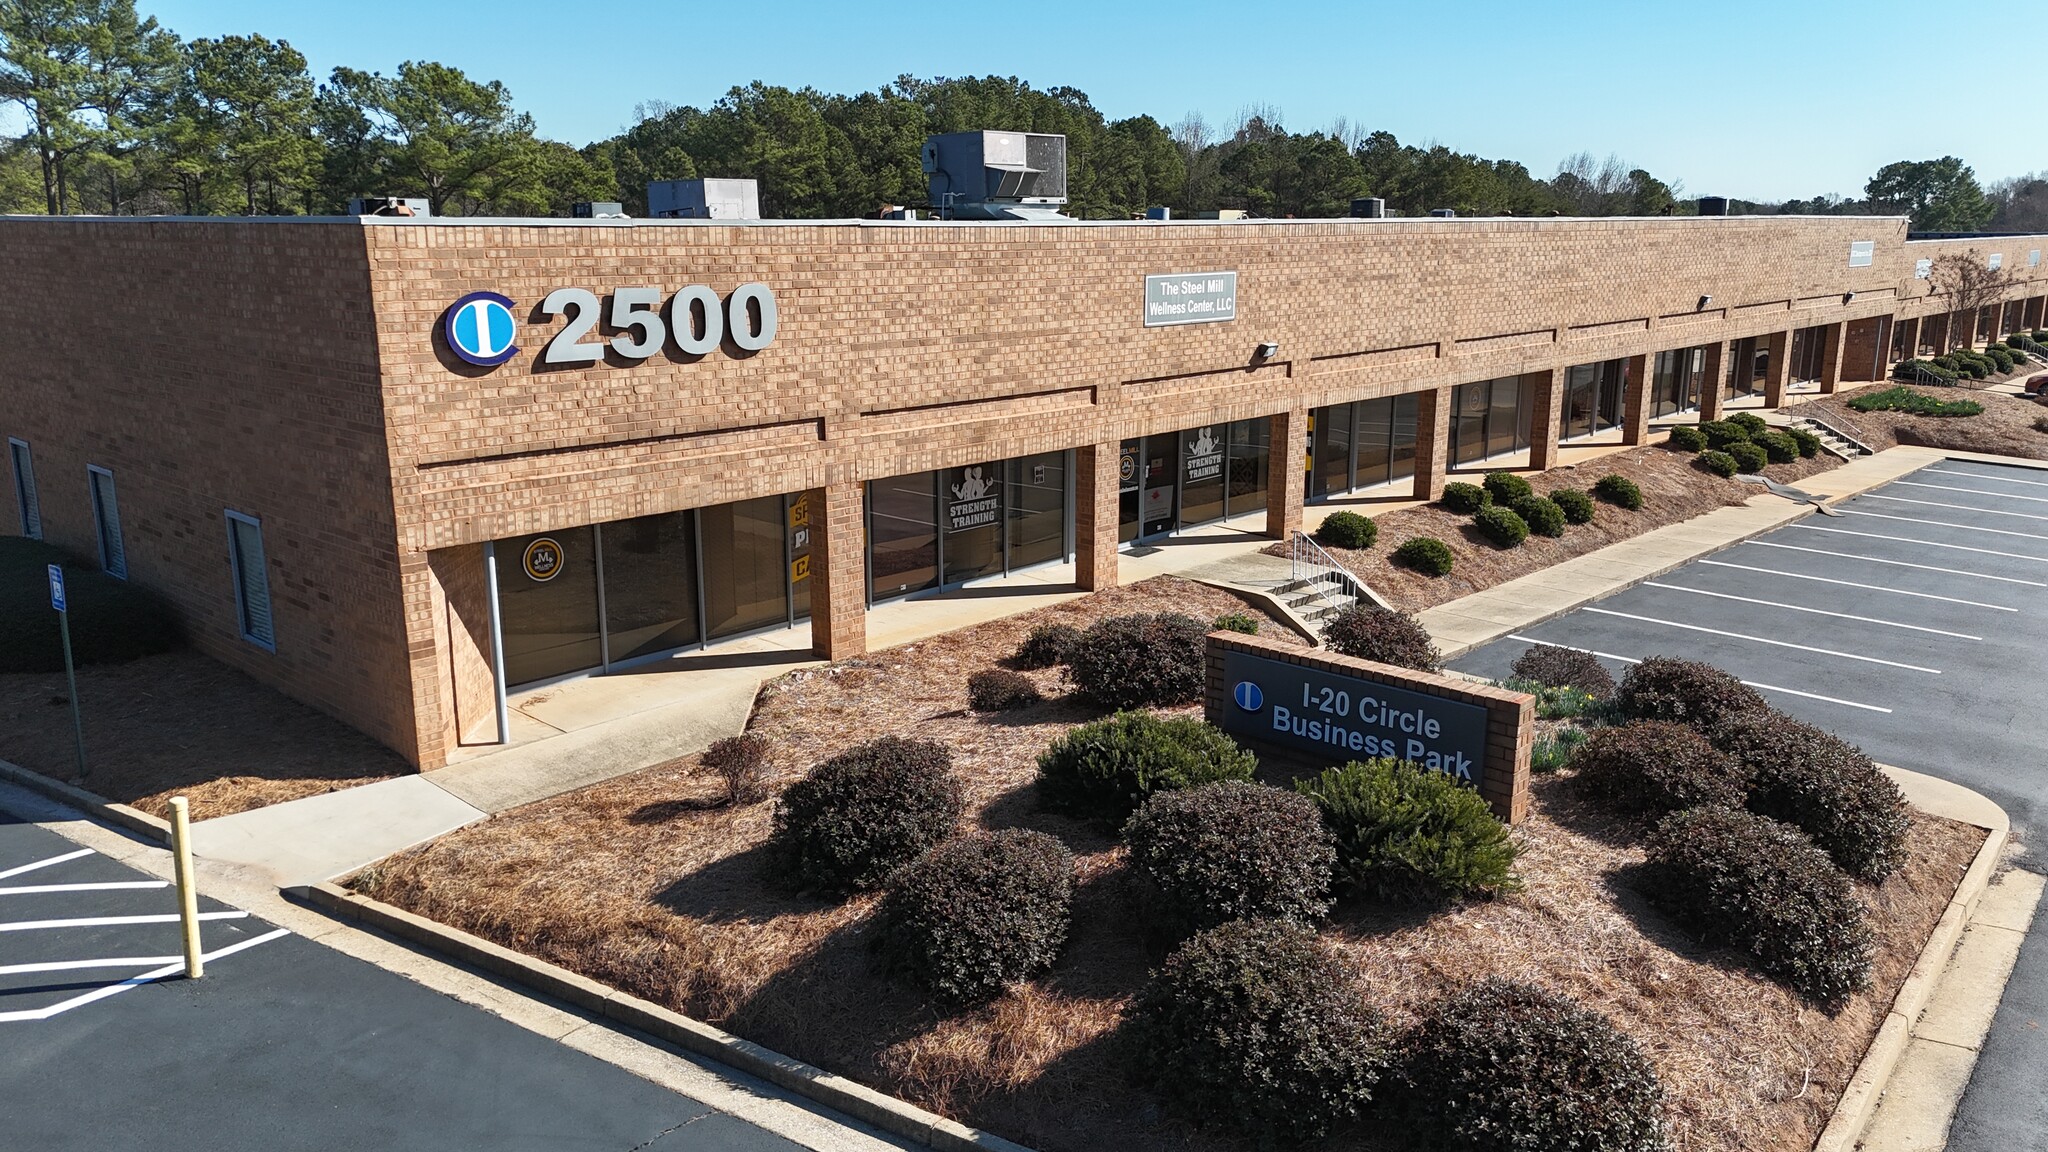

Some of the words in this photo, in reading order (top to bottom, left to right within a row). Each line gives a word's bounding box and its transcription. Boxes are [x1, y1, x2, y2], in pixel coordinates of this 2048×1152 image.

[1160, 282, 1178, 295] The
[1181, 280, 1205, 295] Steel
[1208, 279, 1223, 292] Mill
[1150, 302, 1185, 315] Wellness
[1187, 300, 1214, 313] Center,
[1217, 297, 1231, 311] LLC
[542, 283, 778, 363] 2500
[1187, 454, 1222, 469] STRENGTH
[1189, 464, 1220, 479] TRAINING
[950, 498, 997, 517] STRENGTH
[952, 511, 995, 528] TRAINING
[1302, 682, 1350, 717] I-20
[1358, 697, 1441, 740] Circle
[1272, 704, 1396, 758] Business
[1406, 738, 1472, 780] Park
